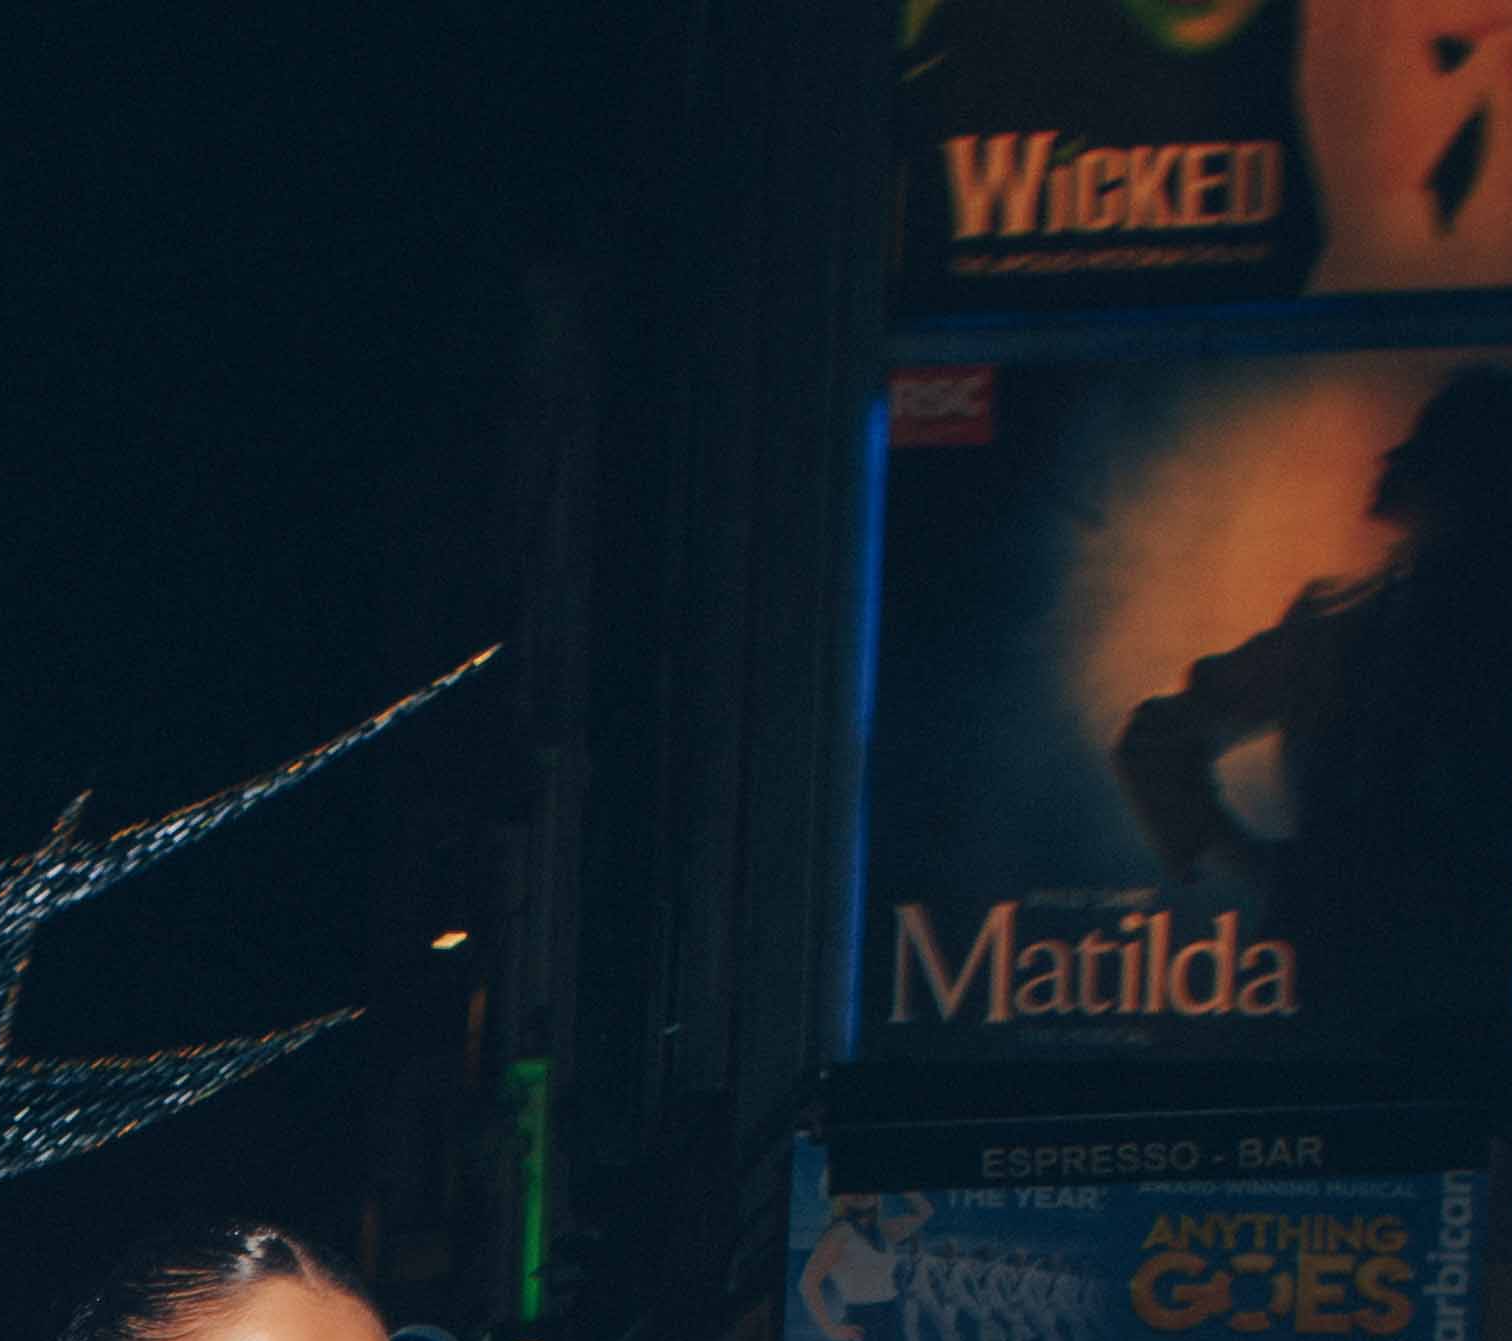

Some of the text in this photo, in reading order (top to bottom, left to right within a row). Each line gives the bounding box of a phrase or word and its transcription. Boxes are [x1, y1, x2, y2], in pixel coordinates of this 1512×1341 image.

[888, 900, 1299, 1024] Matilda
[980, 1140, 1202, 1179] ESPRESSO
[1235, 1136, 1325, 1169] BAR
[947, 1187, 1007, 1209] THE
[1139, 1214, 1409, 1252] ANYTHING
[1130, 1252, 1415, 1336] GOES
